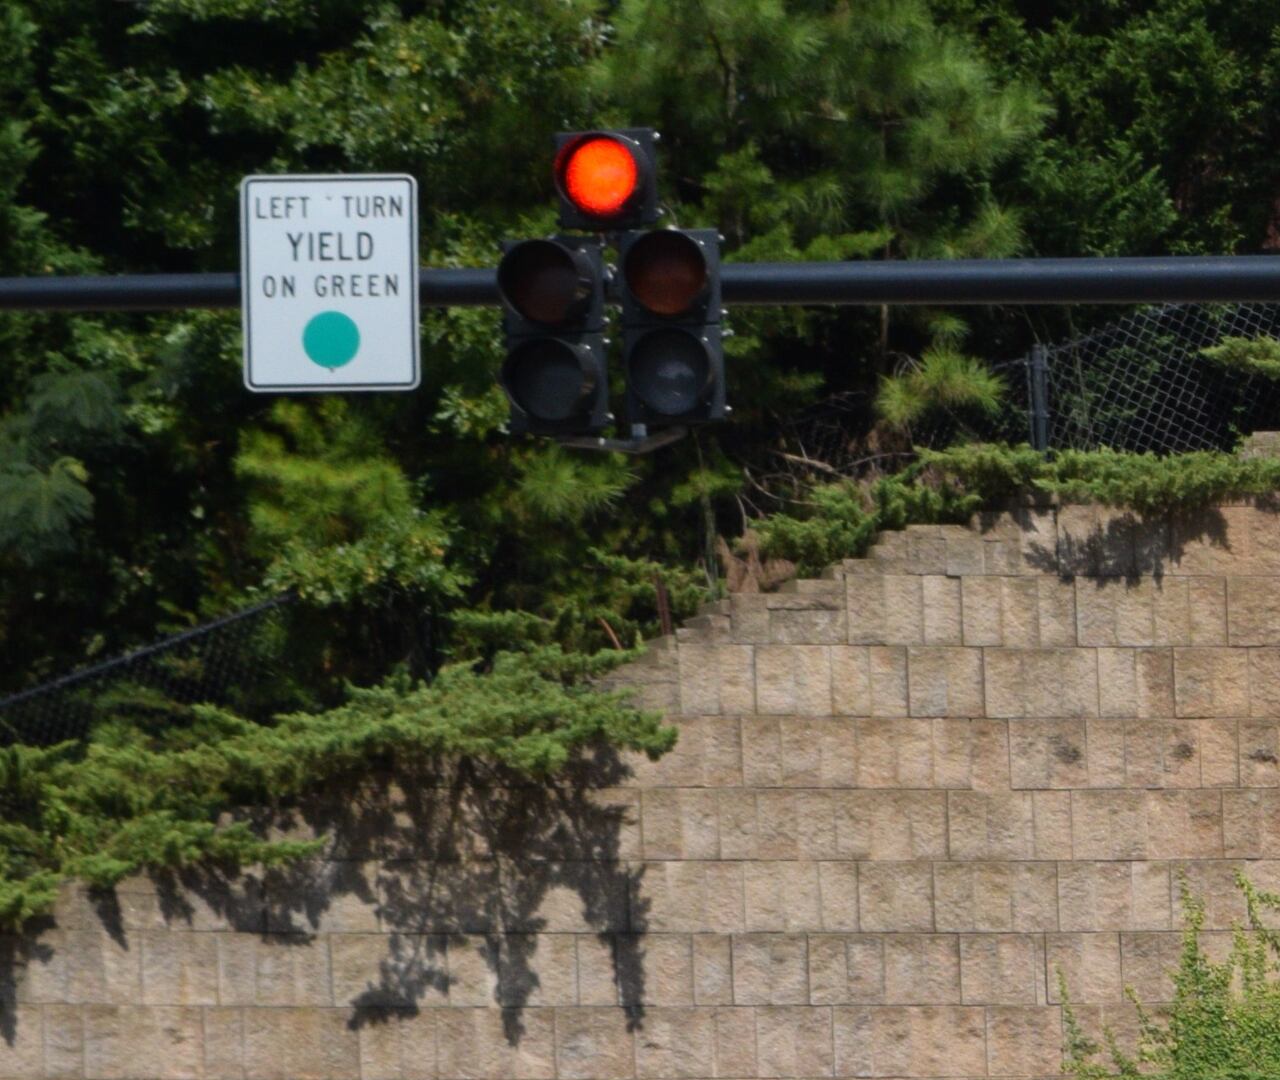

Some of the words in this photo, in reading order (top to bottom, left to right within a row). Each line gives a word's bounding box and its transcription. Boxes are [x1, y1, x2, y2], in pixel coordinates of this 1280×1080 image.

[255, 197, 310, 219] LEFT
[343, 196, 403, 218] TURN
[287, 232, 374, 261] YIELD
[262, 275, 296, 298] ON
[314, 274, 399, 297] GREEN
